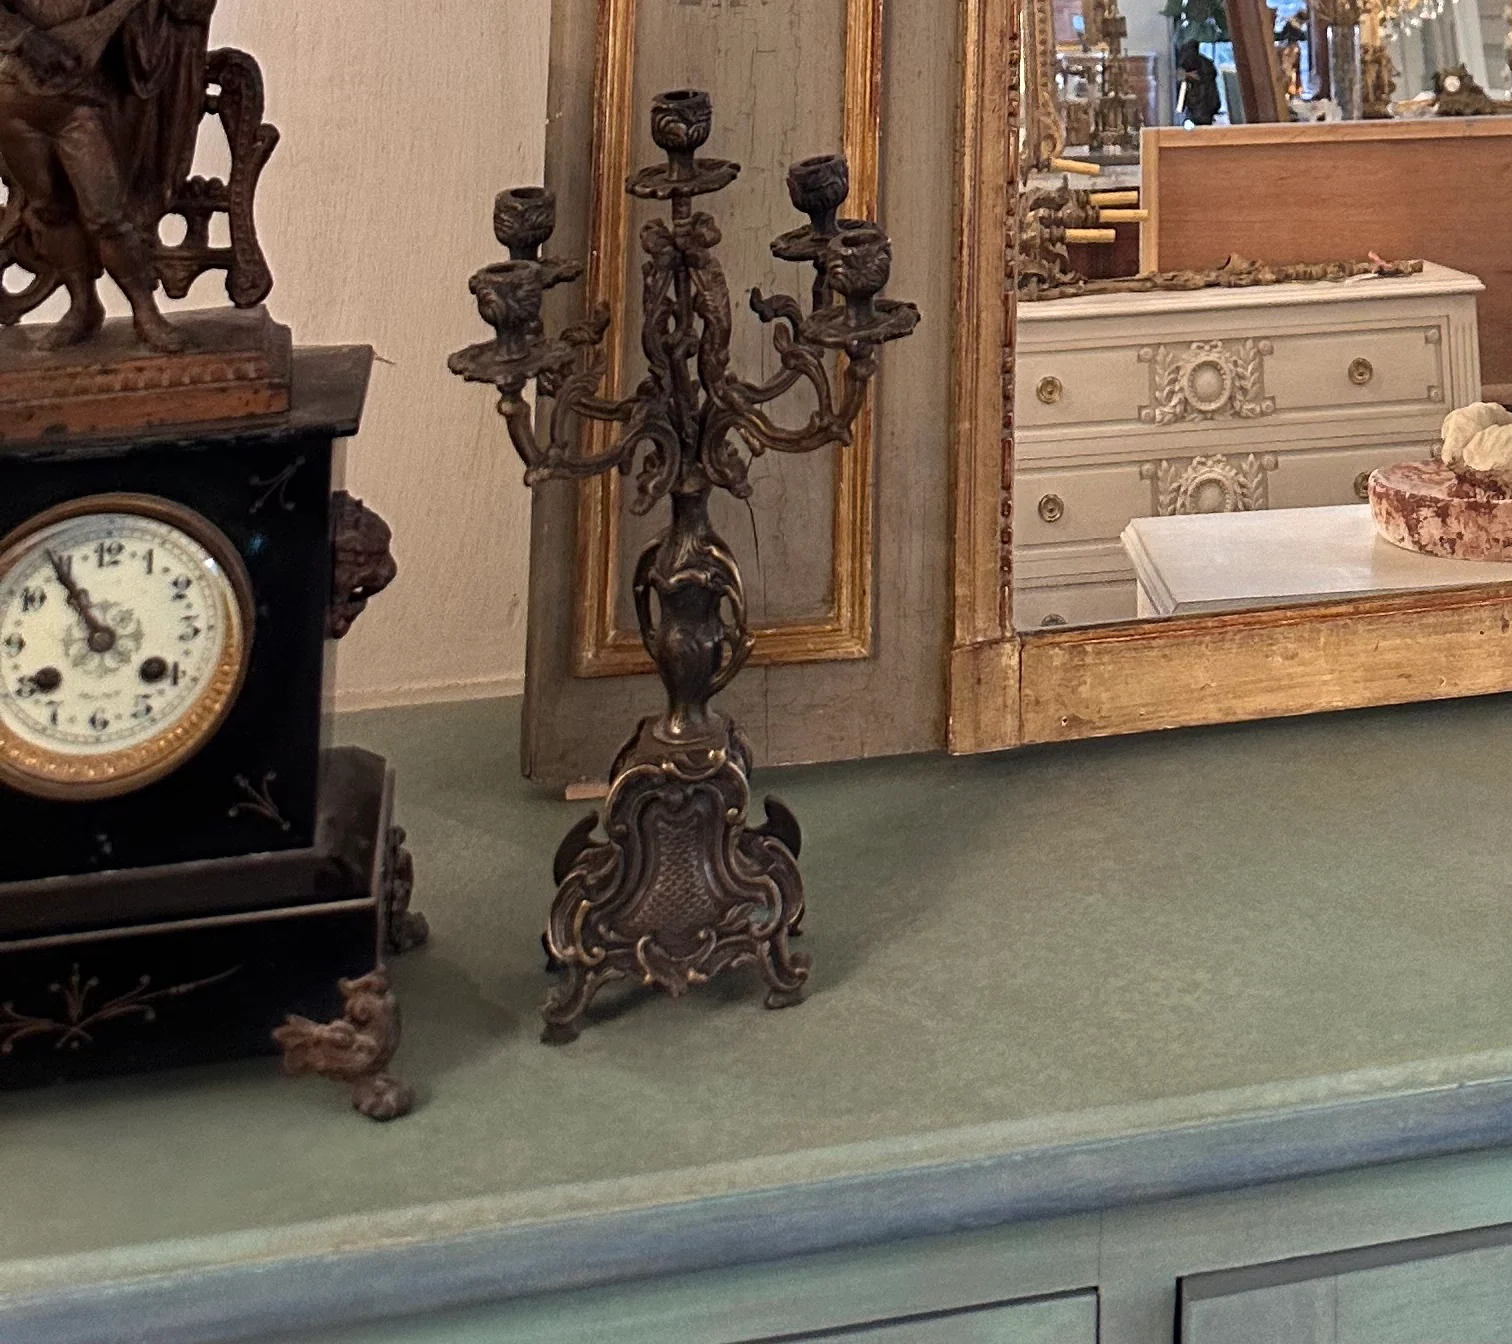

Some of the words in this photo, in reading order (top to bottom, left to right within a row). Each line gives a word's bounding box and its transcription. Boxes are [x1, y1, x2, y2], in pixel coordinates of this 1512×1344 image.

[94, 542, 125, 568] 12
[19, 584, 48, 612] 10
[171, 573, 193, 602] 2
[178, 614, 201, 642] 3
[4, 631, 26, 658] 9
[45, 698, 63, 727] 7
[88, 705, 110, 731] 6
[131, 693, 154, 720] 5
